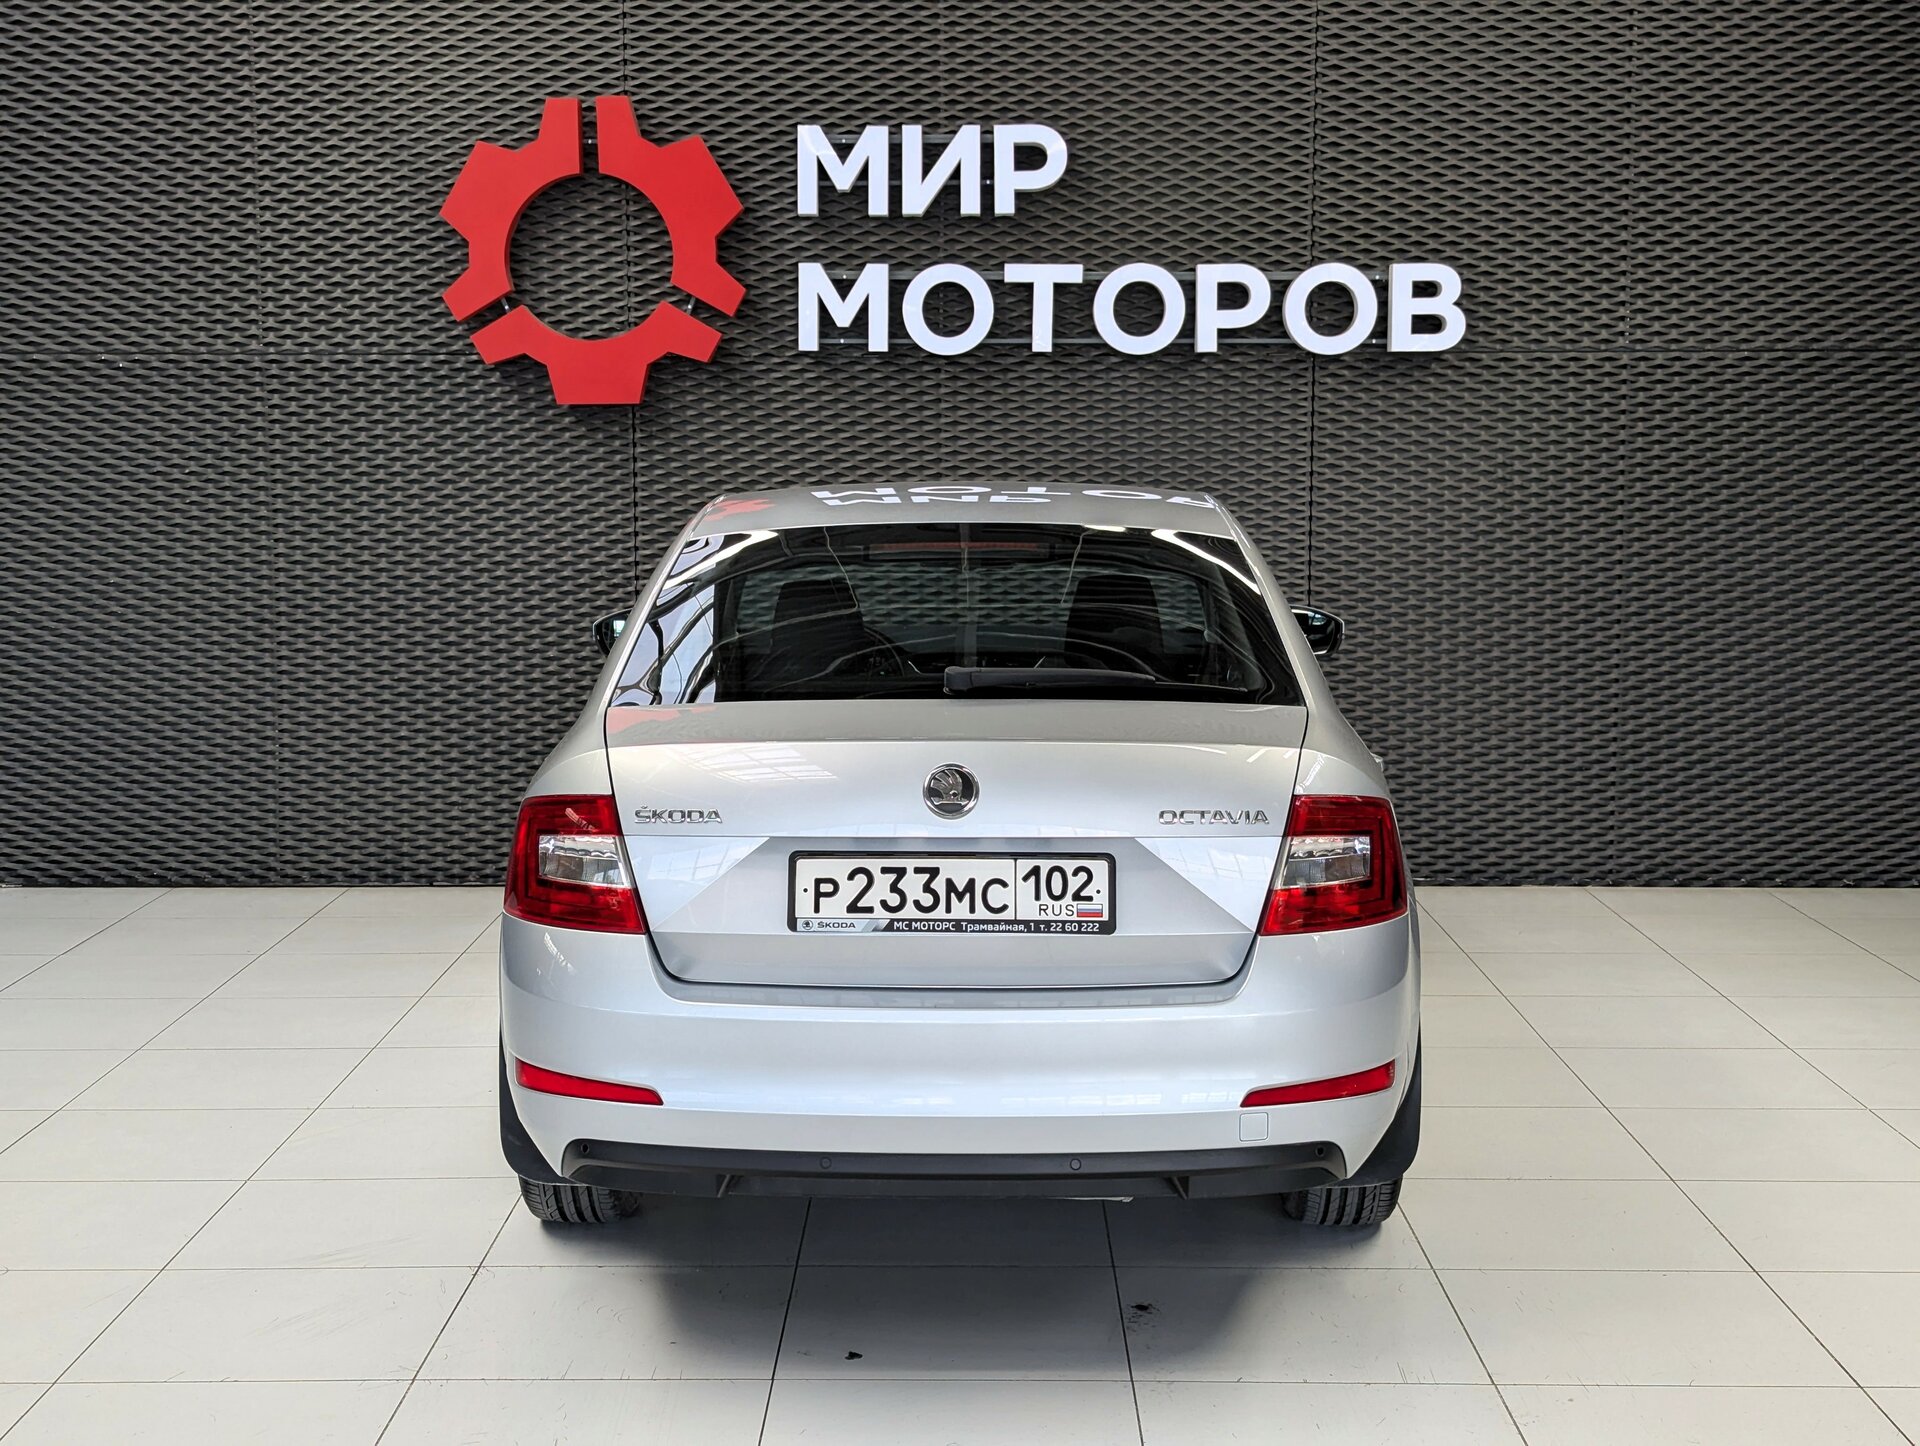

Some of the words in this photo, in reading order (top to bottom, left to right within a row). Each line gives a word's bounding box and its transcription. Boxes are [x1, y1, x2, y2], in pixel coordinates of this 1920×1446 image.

[797, 123, 1069, 217] МИР
[797, 262, 1467, 356] МОТОРОВ
[634, 805, 723, 824] ŠKODA
[1158, 810, 1270, 825] OCTAVIA
[813, 866, 1010, 914] Р233МС
[1022, 865, 1095, 902] 102
[1038, 904, 1075, 917] RUS
[817, 921, 856, 929] ŠKODA
[893, 921, 909, 931] МС
[911, 921, 956, 931] МОТОРС
[961, 922, 1027, 933] Трамвайная,
[1030, 922, 1035, 931] 1
[1050, 923, 1062, 931] 22
[1065, 923, 1079, 931] 60
[1081, 923, 1100, 932] 222
